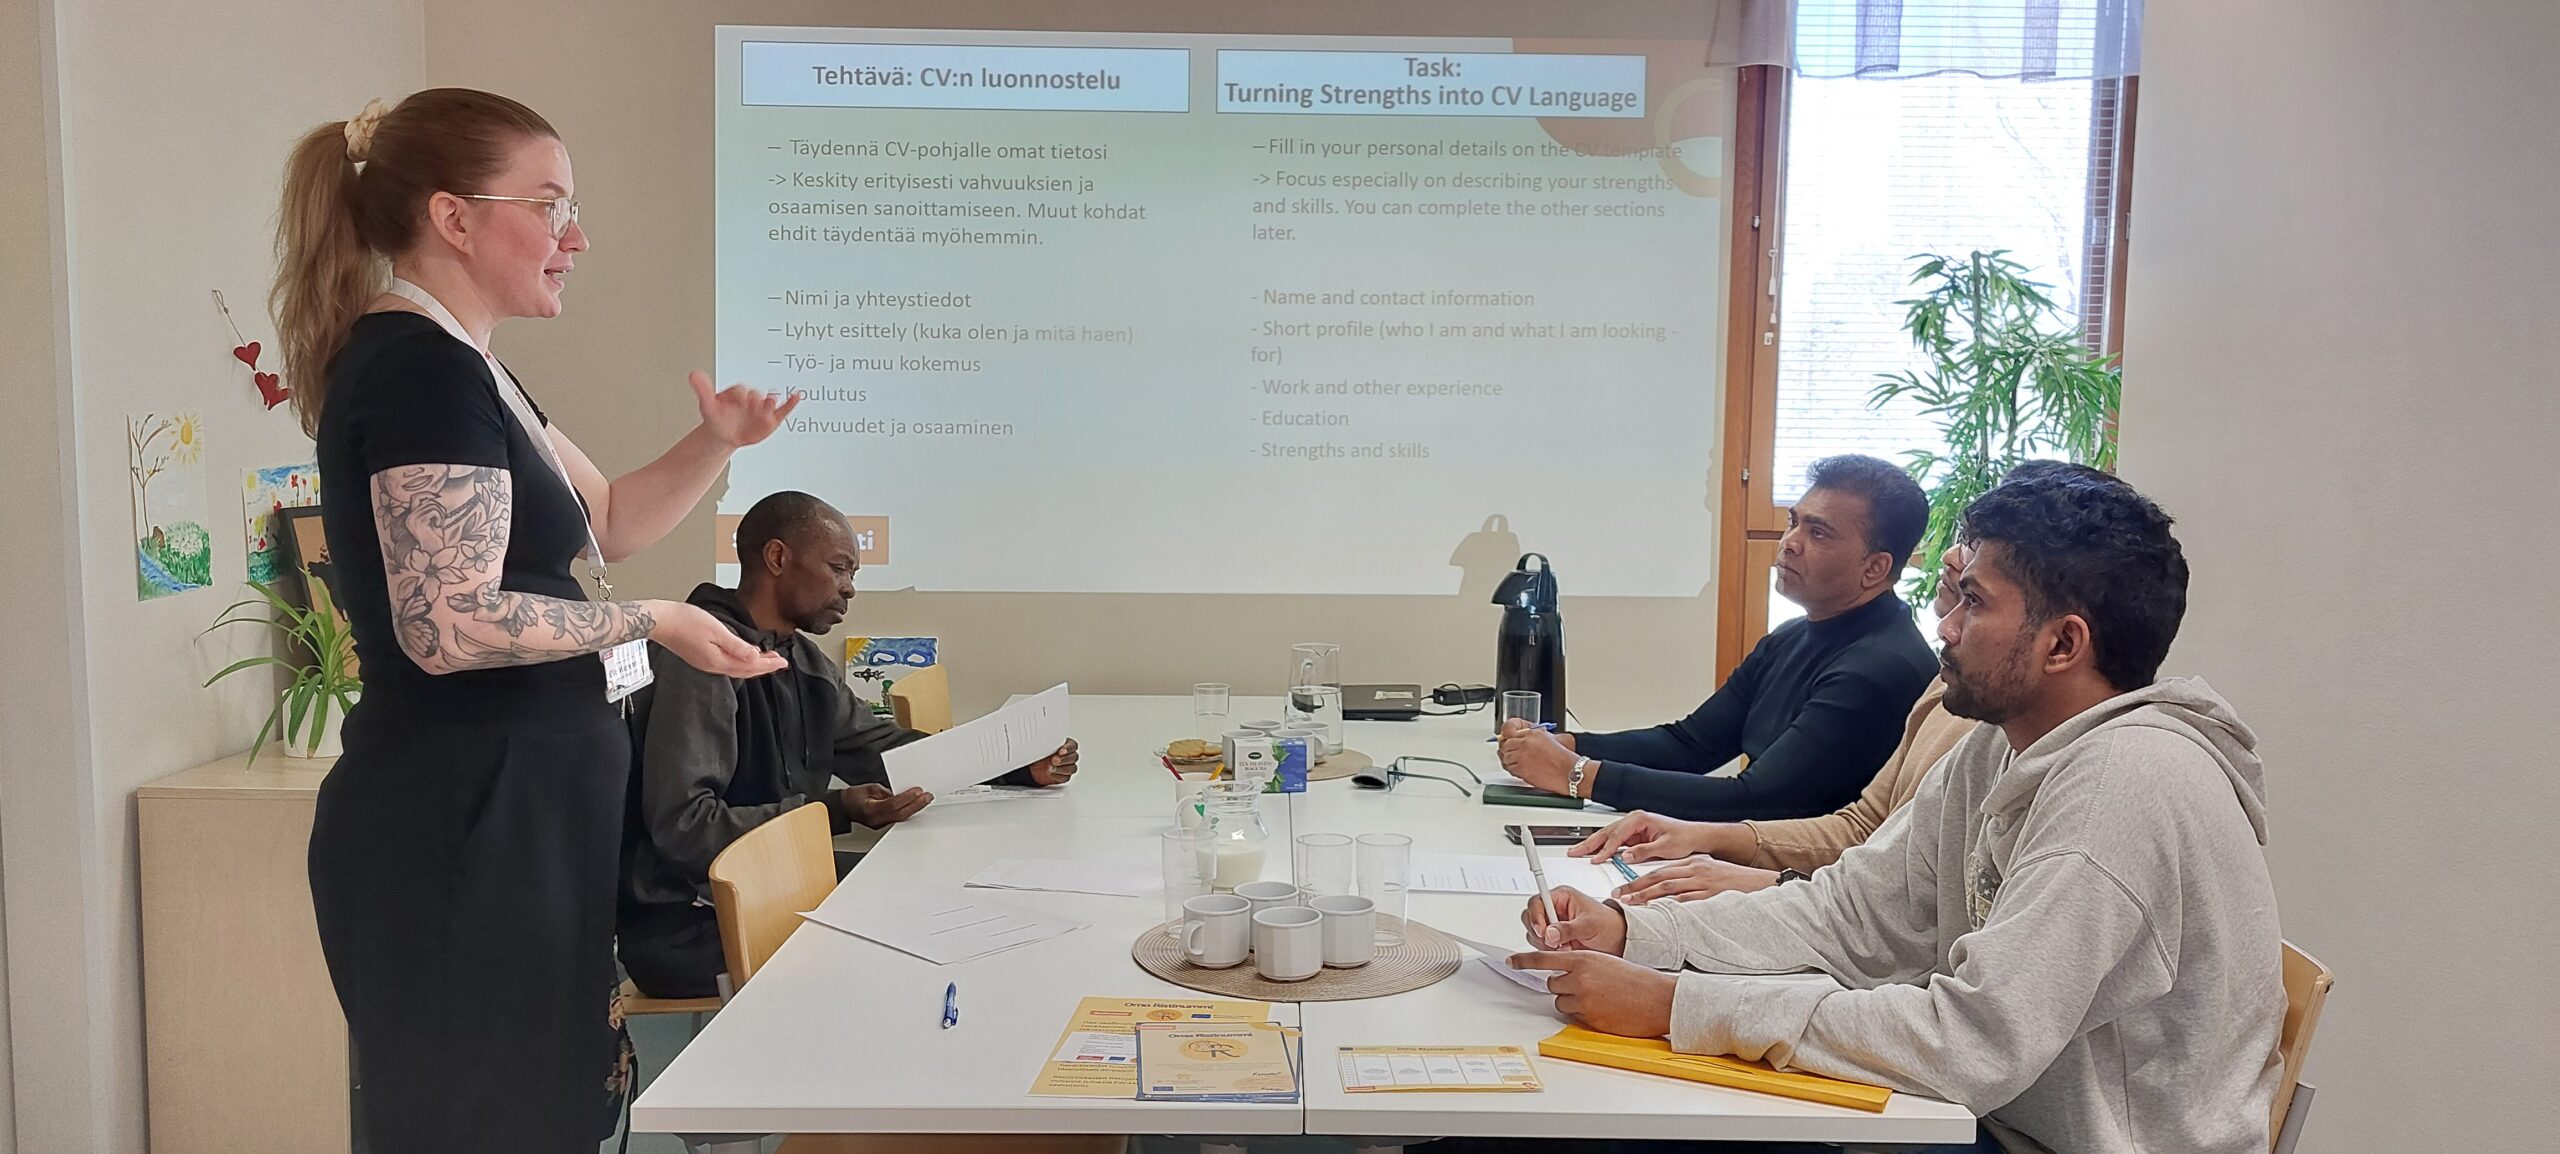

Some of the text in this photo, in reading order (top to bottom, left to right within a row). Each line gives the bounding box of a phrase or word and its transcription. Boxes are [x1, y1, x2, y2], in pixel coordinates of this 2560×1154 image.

[1404, 57, 1461, 77] Task:
[812, 66, 1120, 89] Tehtävä: CV:n luonnostelu
[1224, 83, 1637, 112] Turning Strengths into CV Language
[789, 140, 1106, 160] Täydennä CV-pohjalle omat tietosi
[1270, 138, 1682, 162] Fill in your personal details on the CV template
[794, 172, 1093, 195] Keskity erityisesti vahvuuksien ja
[1277, 171, 1674, 194] Focus especially on describing your strengths
[769, 199, 1146, 219] osaamisen sanoittamiseen. Muut kohdat
[1253, 198, 1665, 218] and skills. You can complete the other sections
[769, 225, 1042, 246] ehdit täydentää myöhemmin.
[1253, 224, 1295, 240] later.
[786, 290, 971, 310] Nimi ja yhteystiedot
[1264, 289, 1534, 306] Name and contact information
[786, 321, 1132, 345] Lyhyt esittely (kuka olen ja mitä haen)
[1263, 320, 1666, 342] Short profile (who I am and what I am looking
[785, 354, 980, 373] Työ- ja muu kokemus
[1251, 346, 1281, 365] for)
[1262, 379, 1502, 398] Work and other experience
[784, 418, 1012, 437] Vahvuudet ja osaaminen
[1263, 410, 1348, 425] Education
[1262, 442, 1429, 461] Strengths and skills
